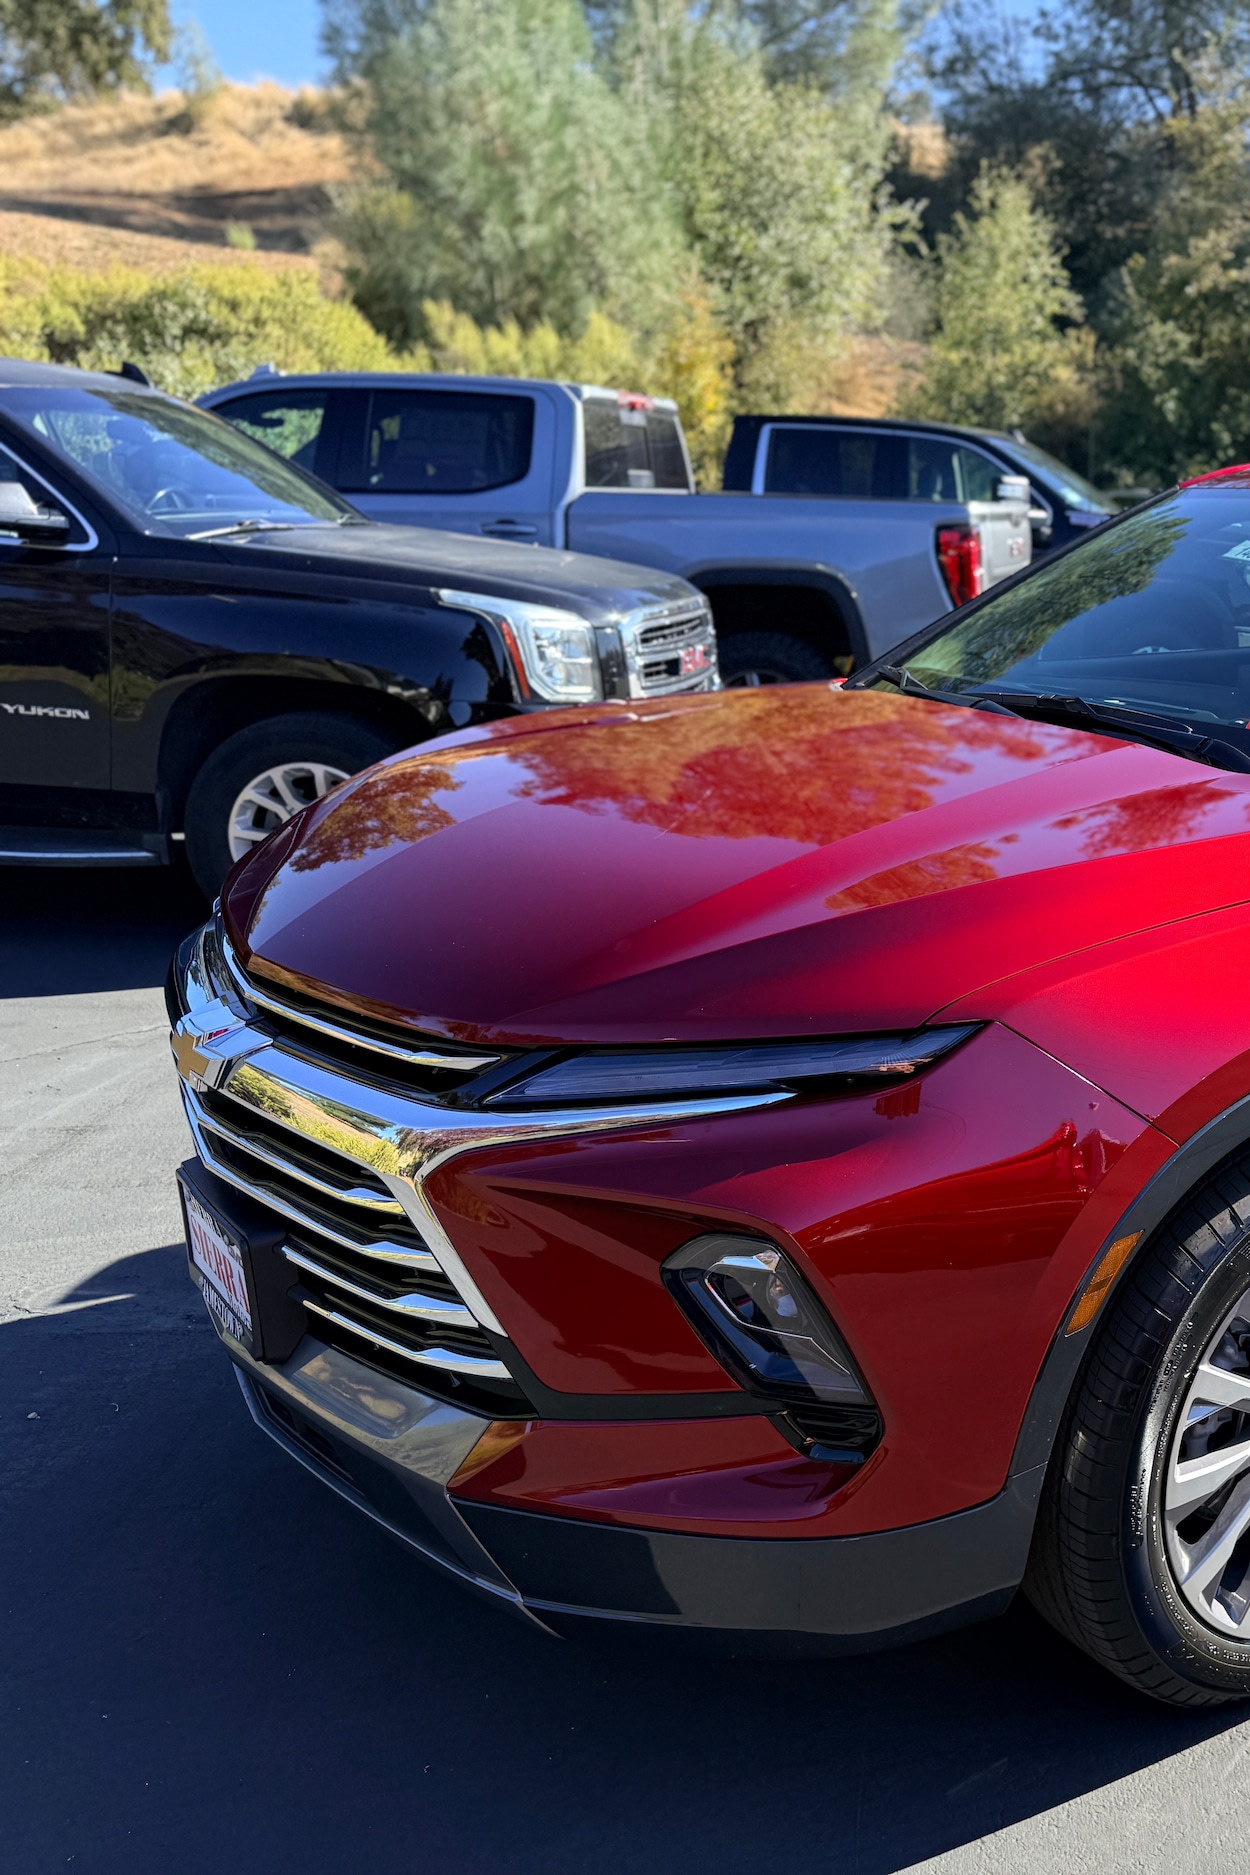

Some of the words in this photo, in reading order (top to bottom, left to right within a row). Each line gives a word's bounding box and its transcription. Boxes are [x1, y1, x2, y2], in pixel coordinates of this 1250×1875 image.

[0, 703, 90, 719] YUKON
[191, 1215, 250, 1315] SIERRA
[203, 1277, 243, 1341] JAMESTOWN
